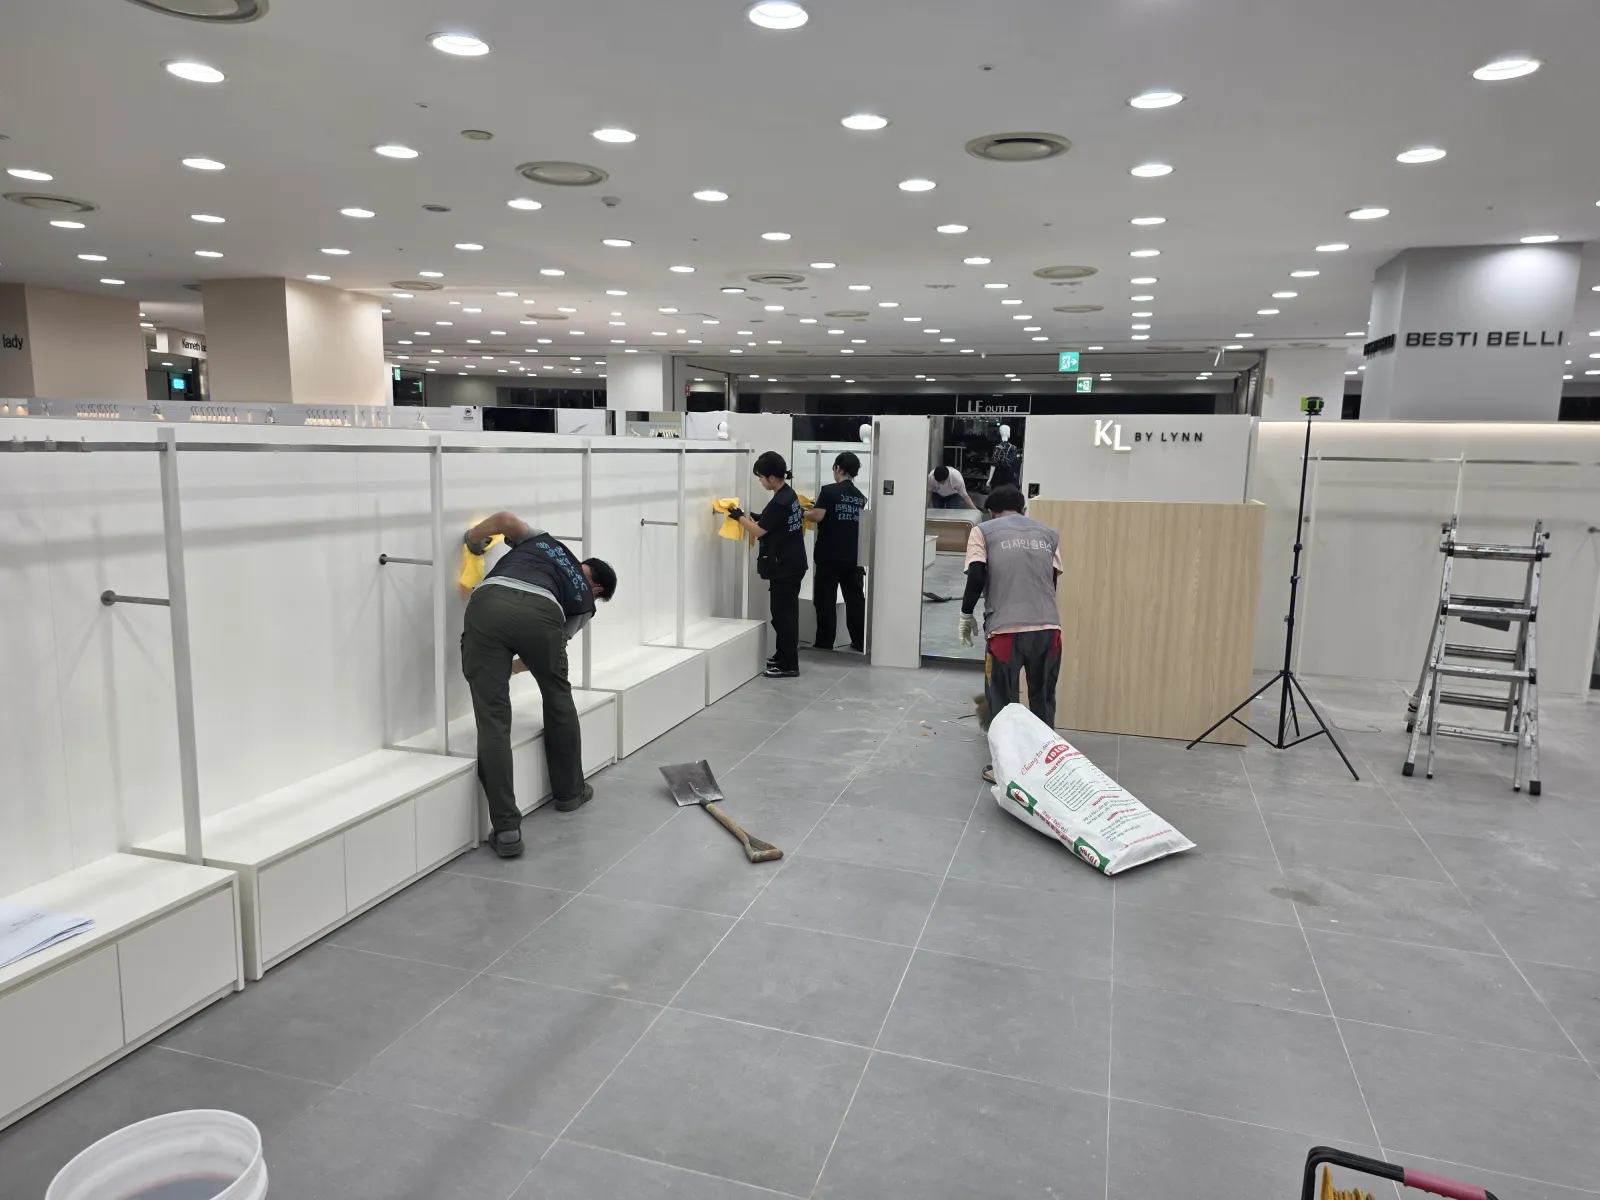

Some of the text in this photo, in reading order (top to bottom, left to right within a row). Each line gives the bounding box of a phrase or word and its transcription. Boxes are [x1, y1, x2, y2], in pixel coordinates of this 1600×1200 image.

[2, 334, 24, 351] lady
[1405, 331, 1478, 347] BESTI
[1486, 330, 1564, 347] BELLI
[967, 400, 1019, 413] LF OUTLET
[1094, 419, 1203, 451] KL BY LYNN
